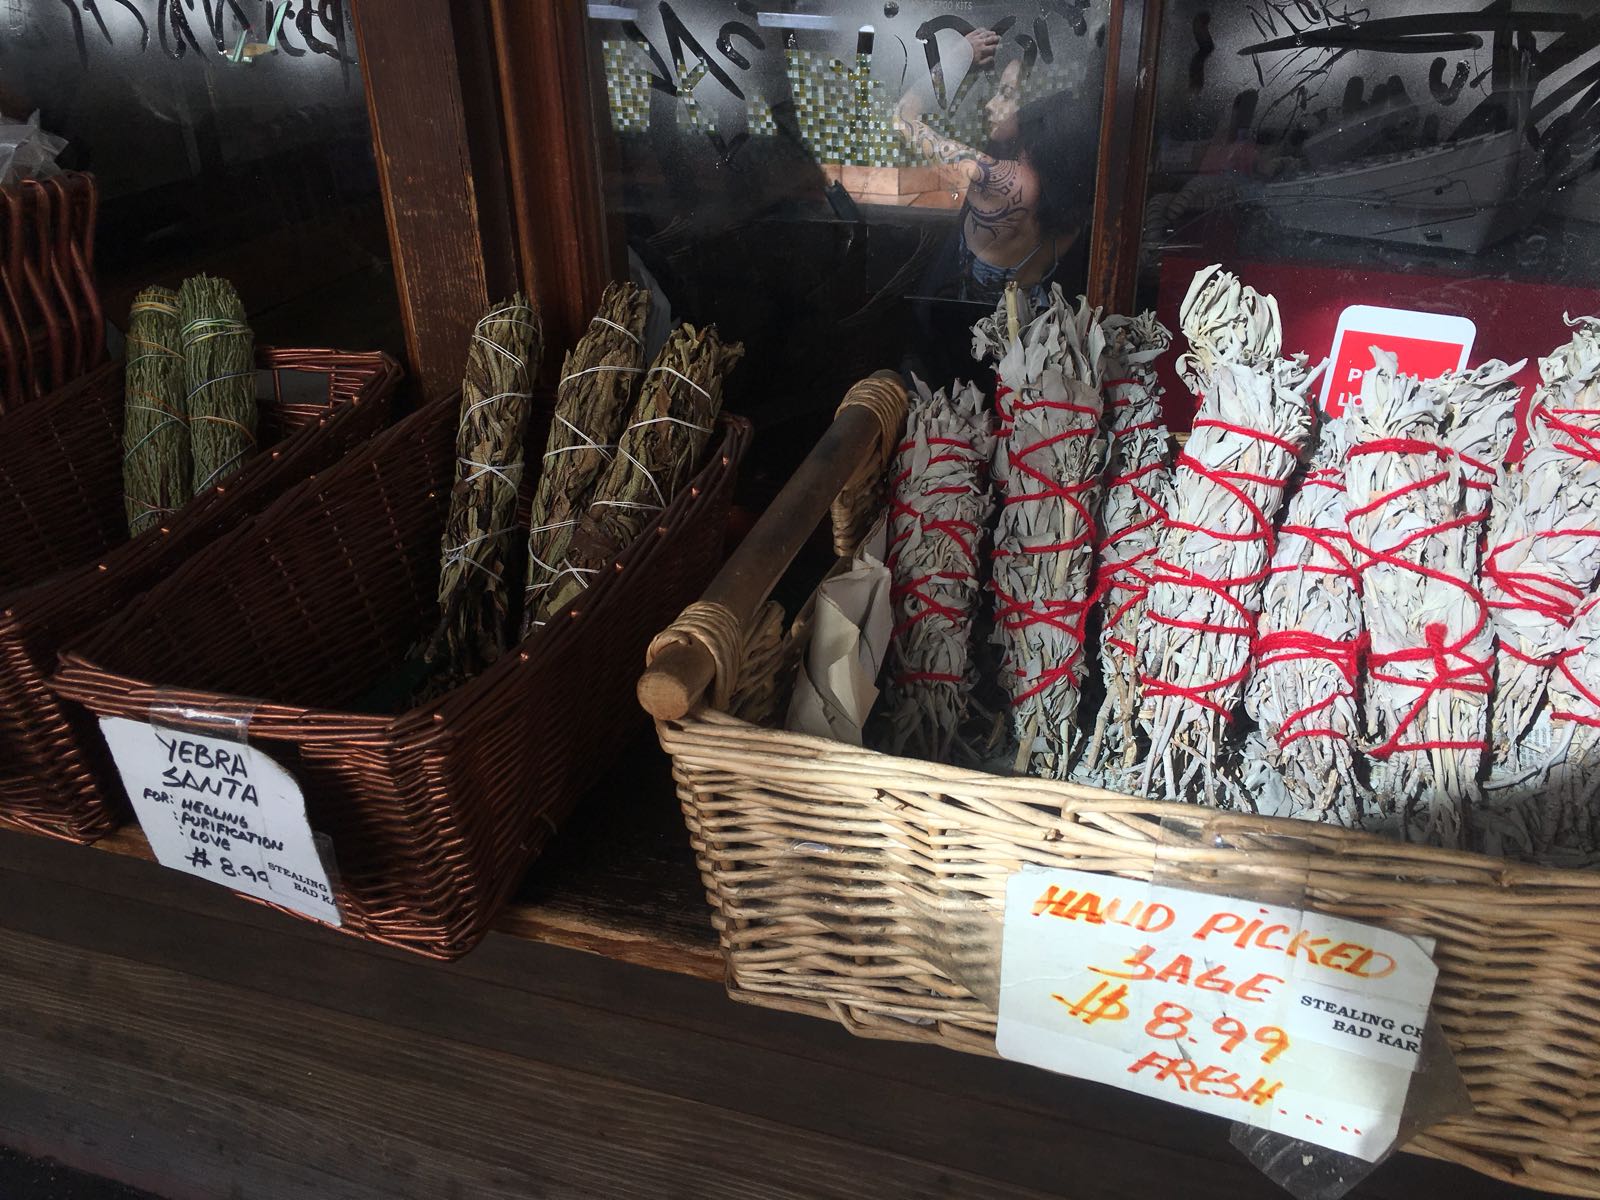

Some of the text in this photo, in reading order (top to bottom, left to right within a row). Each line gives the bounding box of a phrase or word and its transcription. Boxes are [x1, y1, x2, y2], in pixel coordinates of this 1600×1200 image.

[155, 733, 248, 778] YEBRA
[162, 766, 259, 807] SANTA
[181, 798, 249, 829] HEALING
[190, 828, 231, 851] LOVE
[267, 862, 328, 893] STEALING
[293, 882, 319, 898] BAD
[1192, 908, 1397, 979] PICKED
[1087, 944, 1285, 1003] SAGE
[1300, 995, 1396, 1031] STEALING
[1332, 1019, 1373, 1039] BAD
